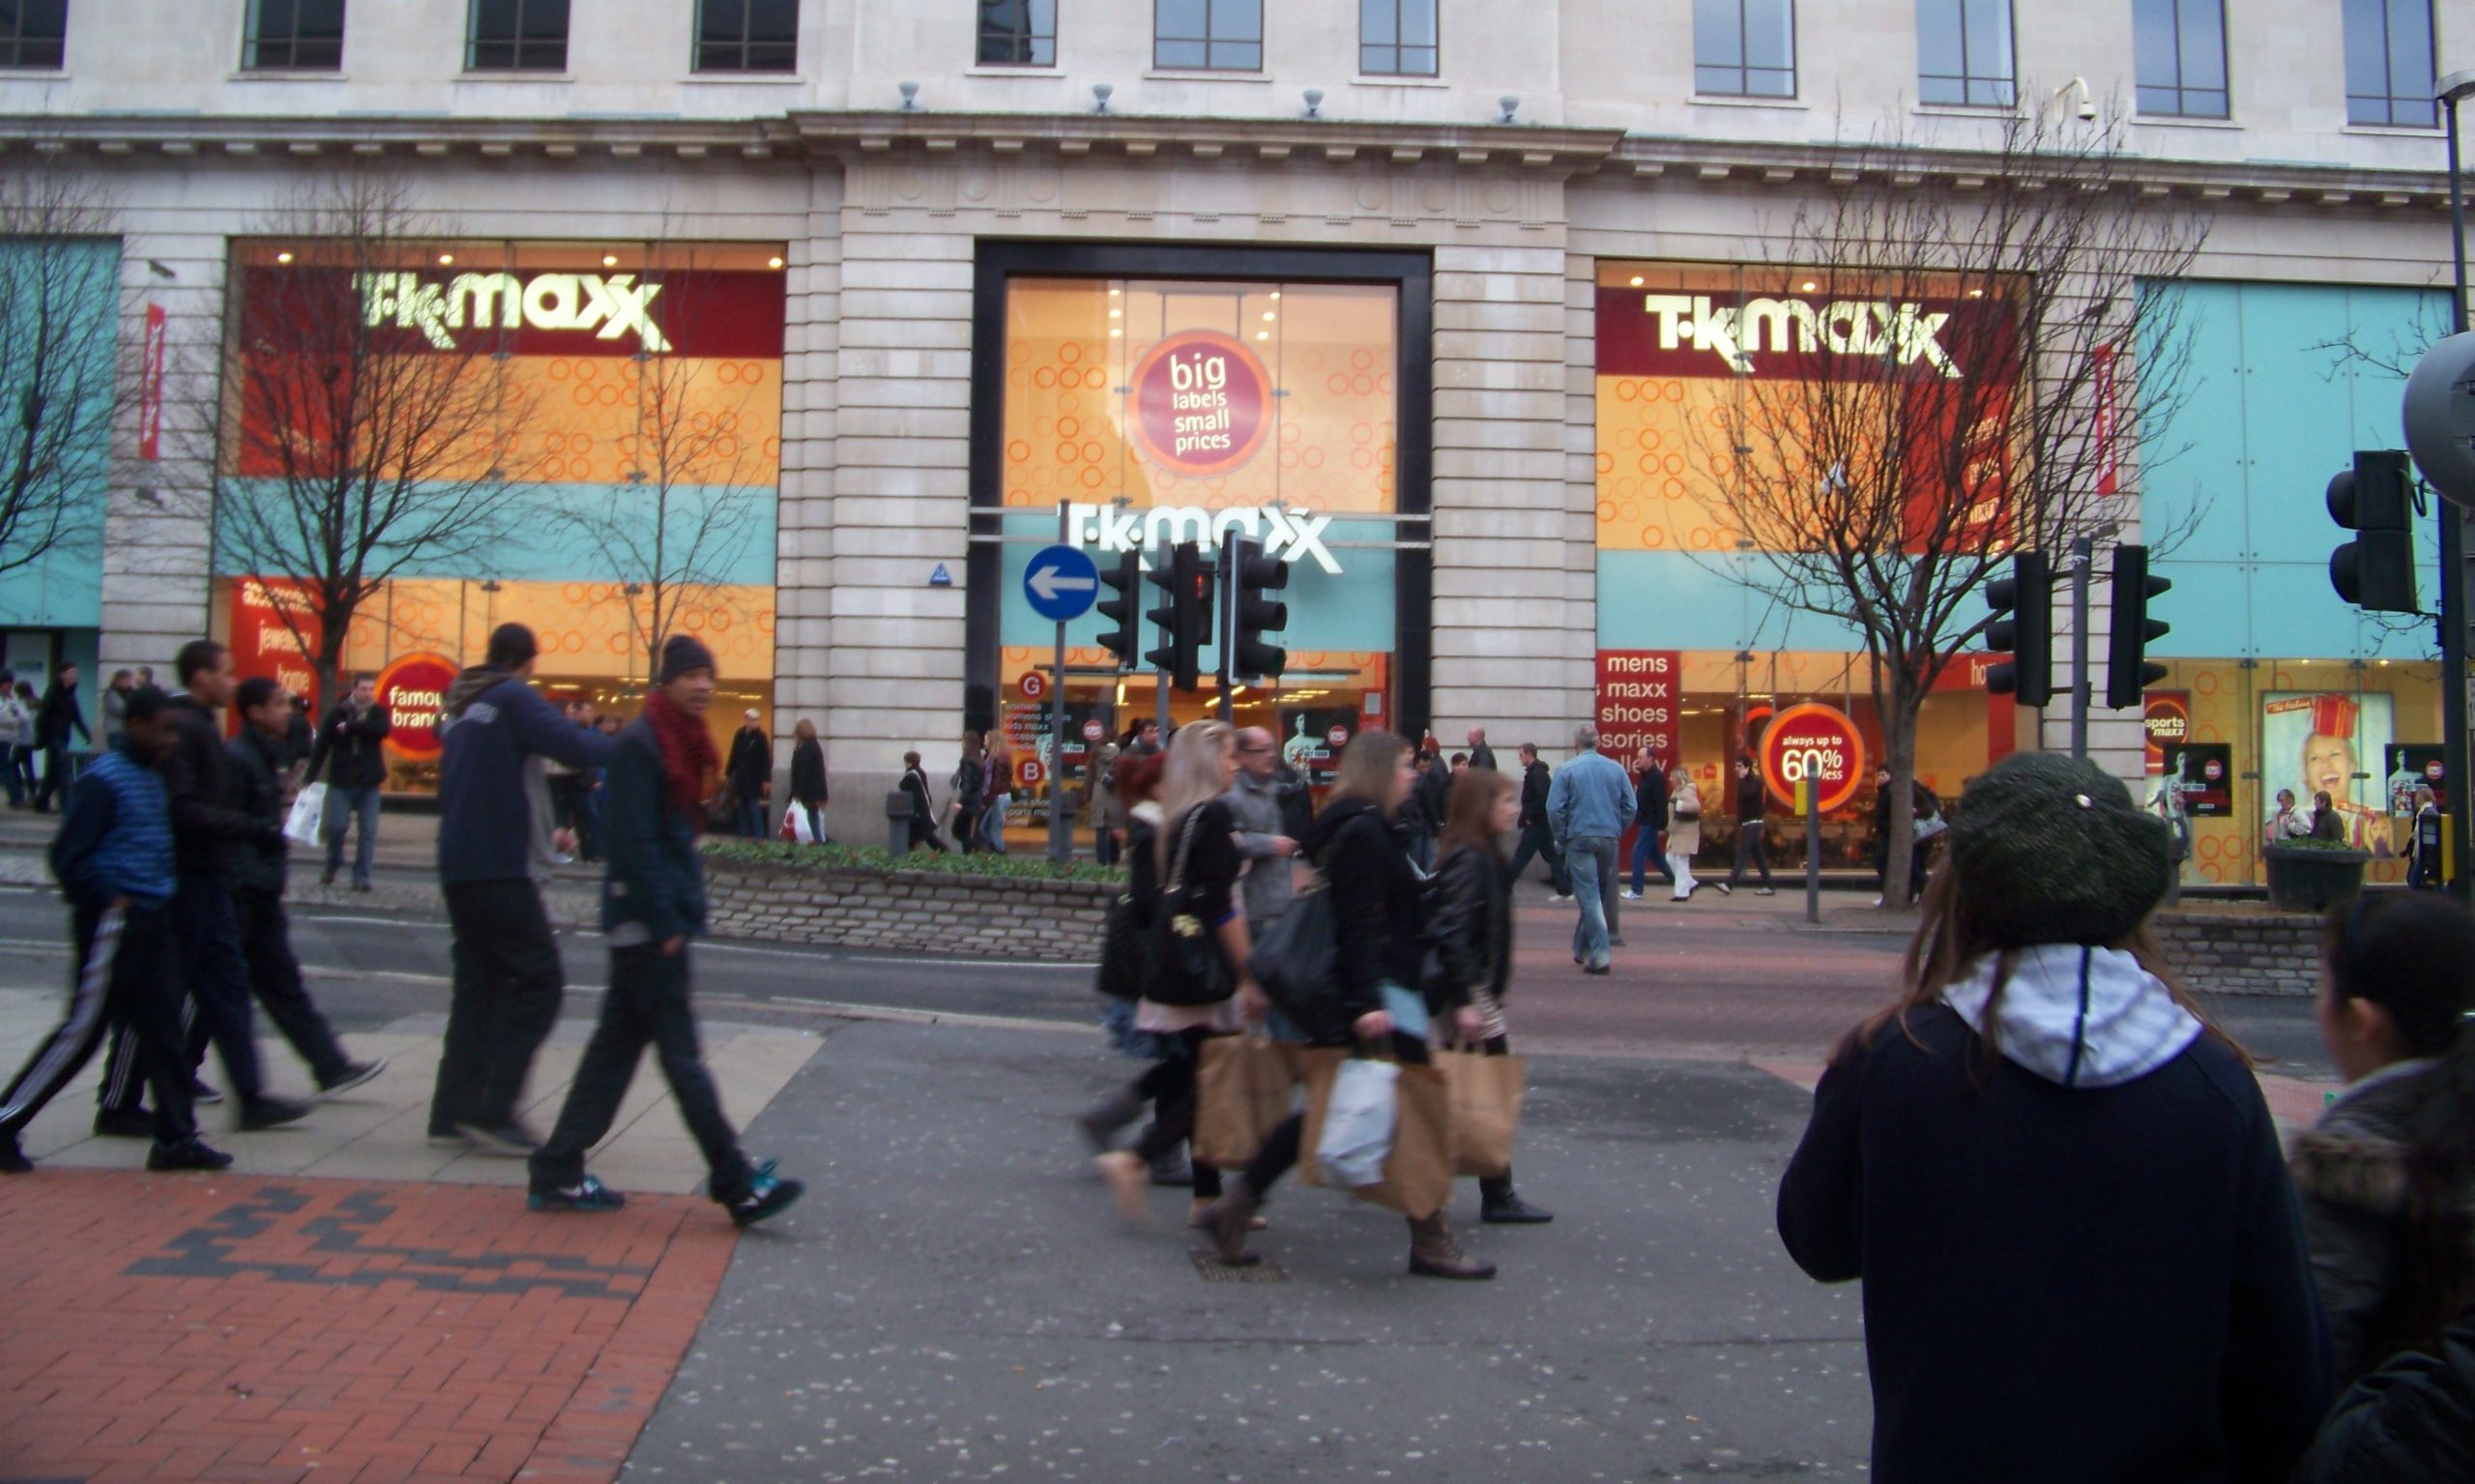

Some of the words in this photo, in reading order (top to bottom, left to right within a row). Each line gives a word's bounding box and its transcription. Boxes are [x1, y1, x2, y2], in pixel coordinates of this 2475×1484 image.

[1170, 352, 1227, 390] big
[1173, 390, 1228, 410] labels
[1174, 408, 1231, 433] small
[1175, 431, 1232, 457] prices
[1607, 656, 1669, 673] mens
[1023, 676, 1041, 696] G
[1607, 682, 1667, 698] maxx
[1601, 703, 1669, 723] shoes
[2144, 717, 2185, 730] sports
[2152, 728, 2185, 737] maxx
[1782, 736, 1816, 747] always
[1817, 738, 1830, 747] up
[1831, 736, 1844, 745] to
[1023, 762, 1039, 781] B
[1821, 769, 1844, 780] less
